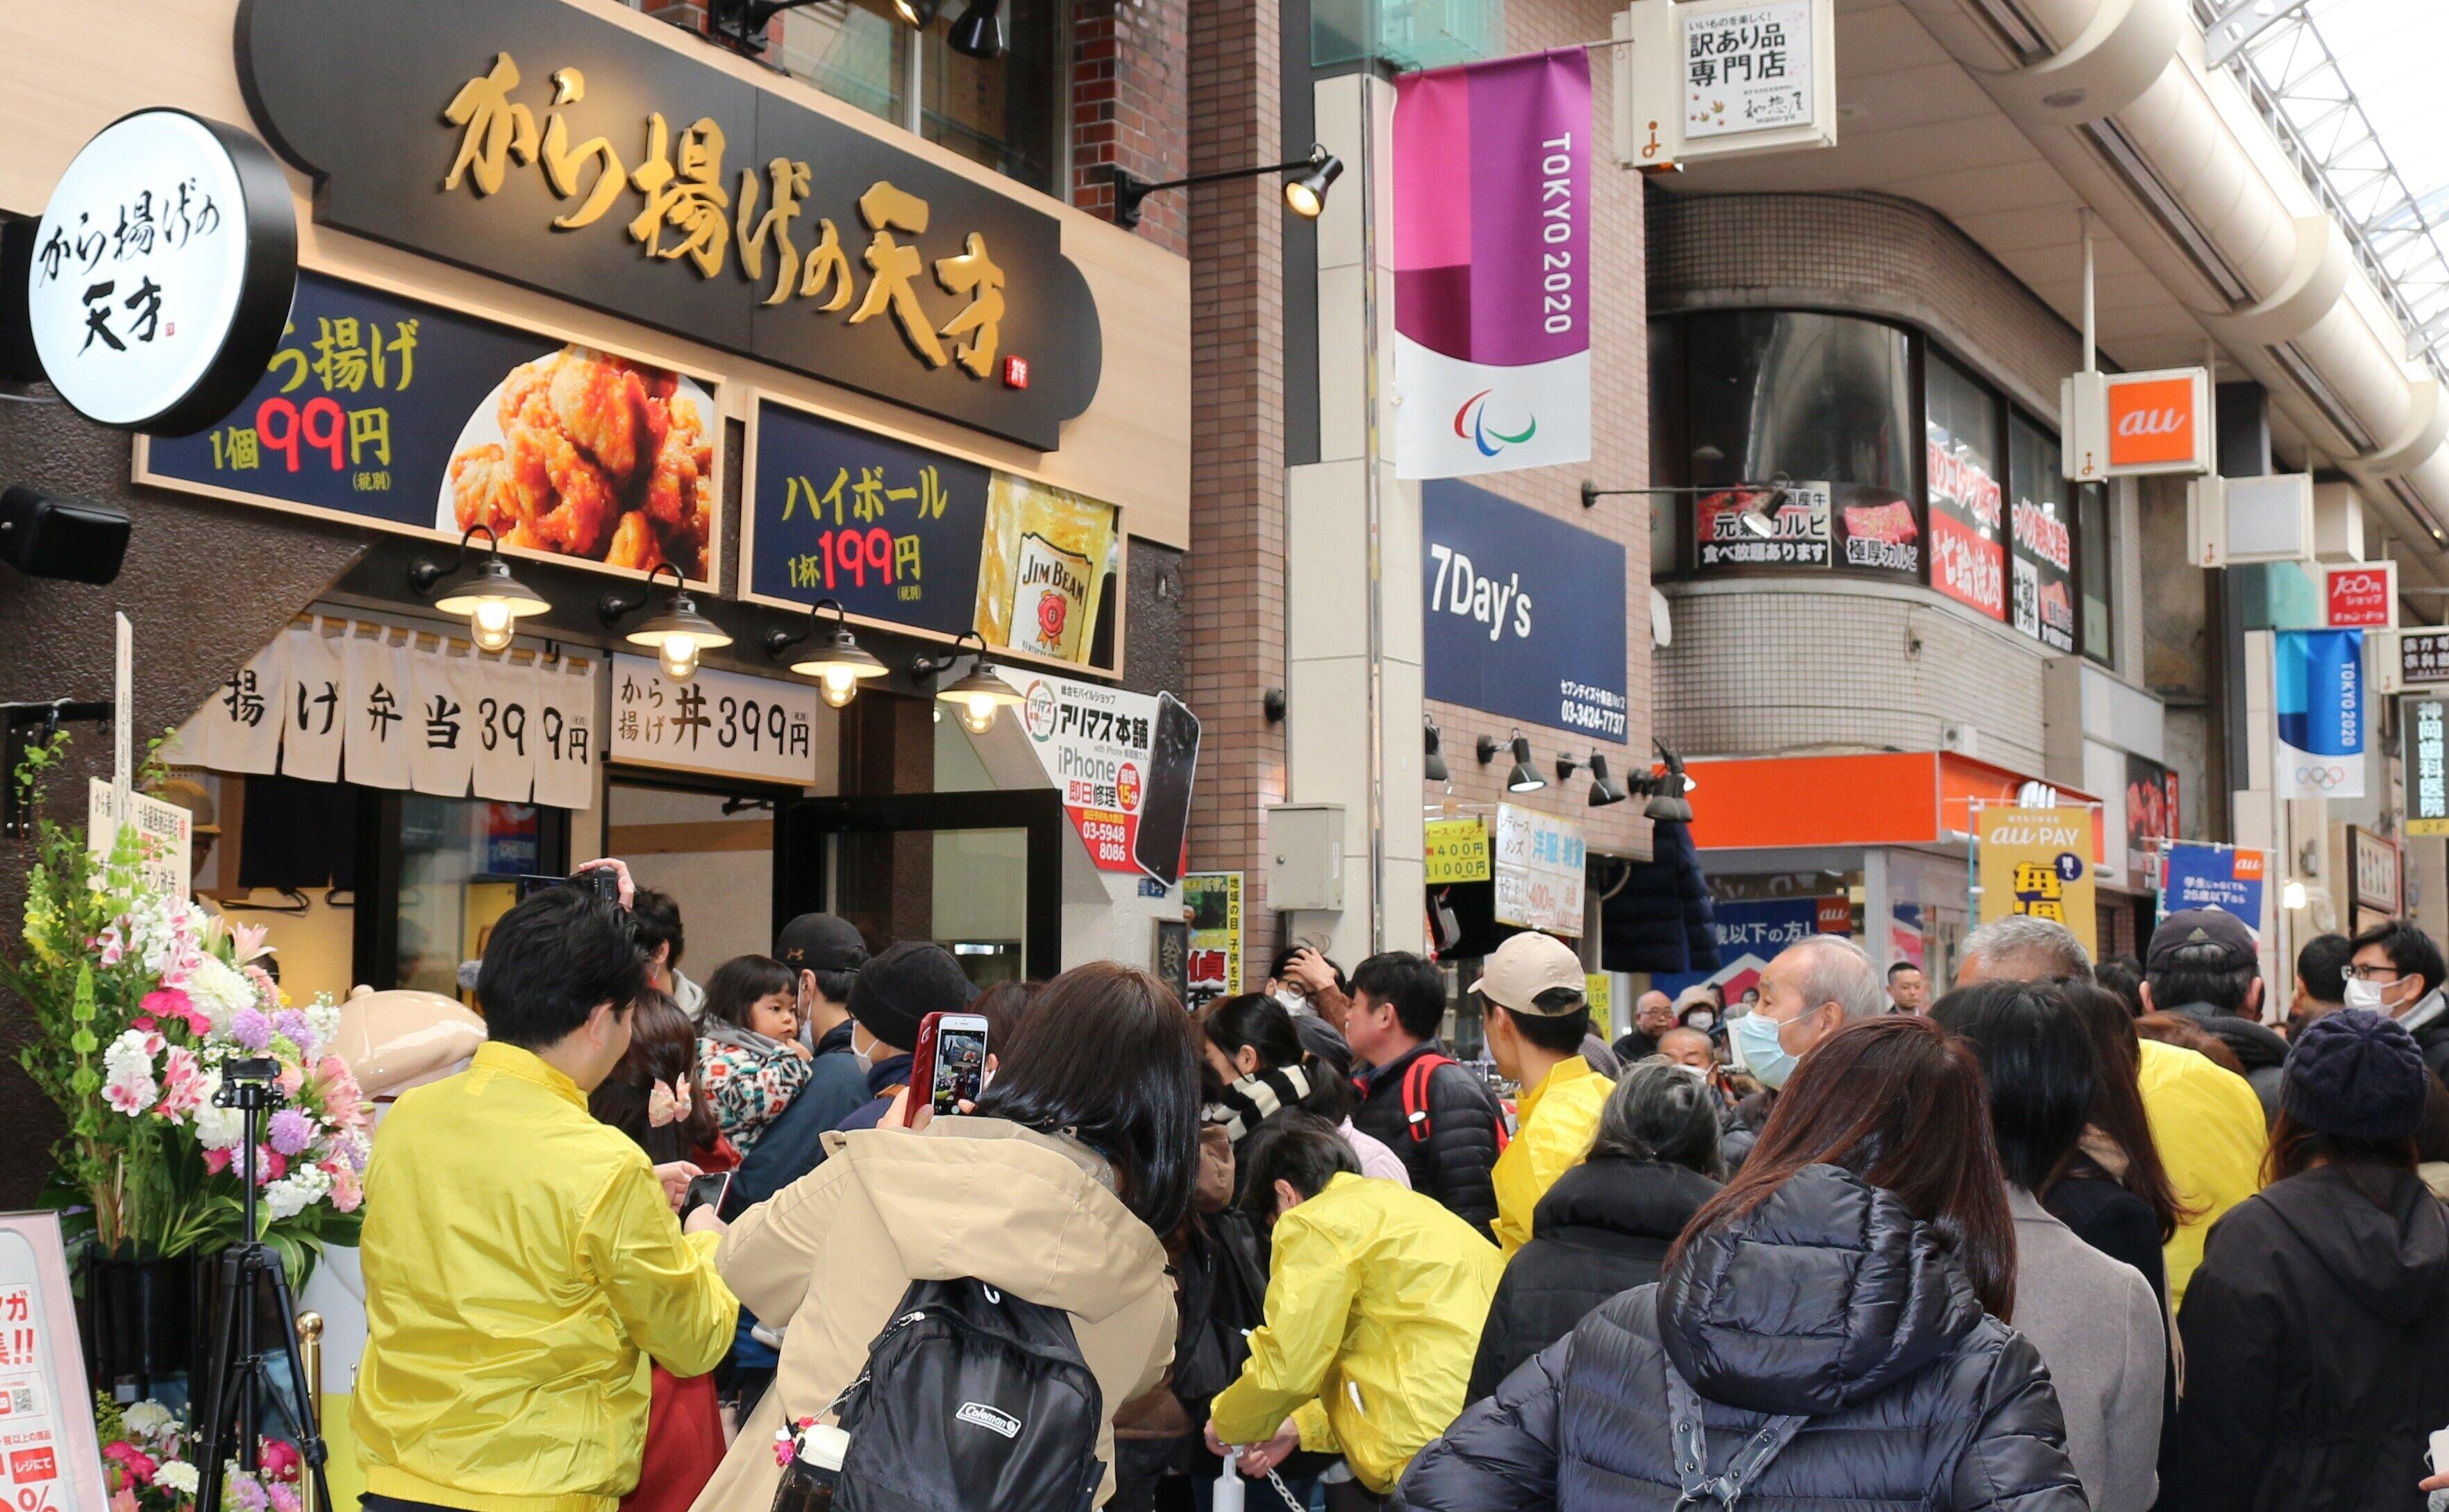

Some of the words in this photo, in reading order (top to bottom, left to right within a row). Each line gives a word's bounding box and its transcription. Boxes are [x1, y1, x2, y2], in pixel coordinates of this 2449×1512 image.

[1690, 22, 1785, 58] 訳あり品
[1689, 51, 1786, 87] 専門店
[1542, 132, 1571, 244] TOKYO
[38, 177, 220, 288] から揚げの
[444, 51, 1005, 378] から揚げの天才
[1544, 251, 1573, 335] 2020
[76, 275, 162, 357] 天才
[2118, 408, 2185, 437] au
[782, 465, 948, 526] ハイボール
[1703, 543, 1826, 563] 食べ放題あります
[1022, 554, 1051, 585] JIM
[1052, 560, 1085, 606] BEAM
[1431, 543, 1532, 641] 7Day's
[621, 674, 663, 708] から
[2341, 662, 2356, 709] TOKYO
[224, 670, 588, 764] 揚げ弁当399円
[618, 709, 664, 745] 揚げ
[1060, 703, 1148, 749] アリマス本舗
[1562, 699, 1625, 735] 03-3424-7737
[2341, 710, 2357, 747] 2020
[1058, 745, 1116, 782] iPhone
[1121, 768, 1137, 785] 最短
[1069, 780, 1116, 807] 即日修理
[1119, 784, 1138, 805] 15分
[1083, 821, 1126, 843] 03-5948
[1991, 826, 2036, 845] au
[2039, 828, 2079, 846] PAY
[1099, 842, 1126, 862] 8086
[2236, 859, 2263, 871] au
[1819, 909, 1848, 921] au
[0, 1290, 29, 1322] ガ
[15, 1456, 53, 1473] レジにて
